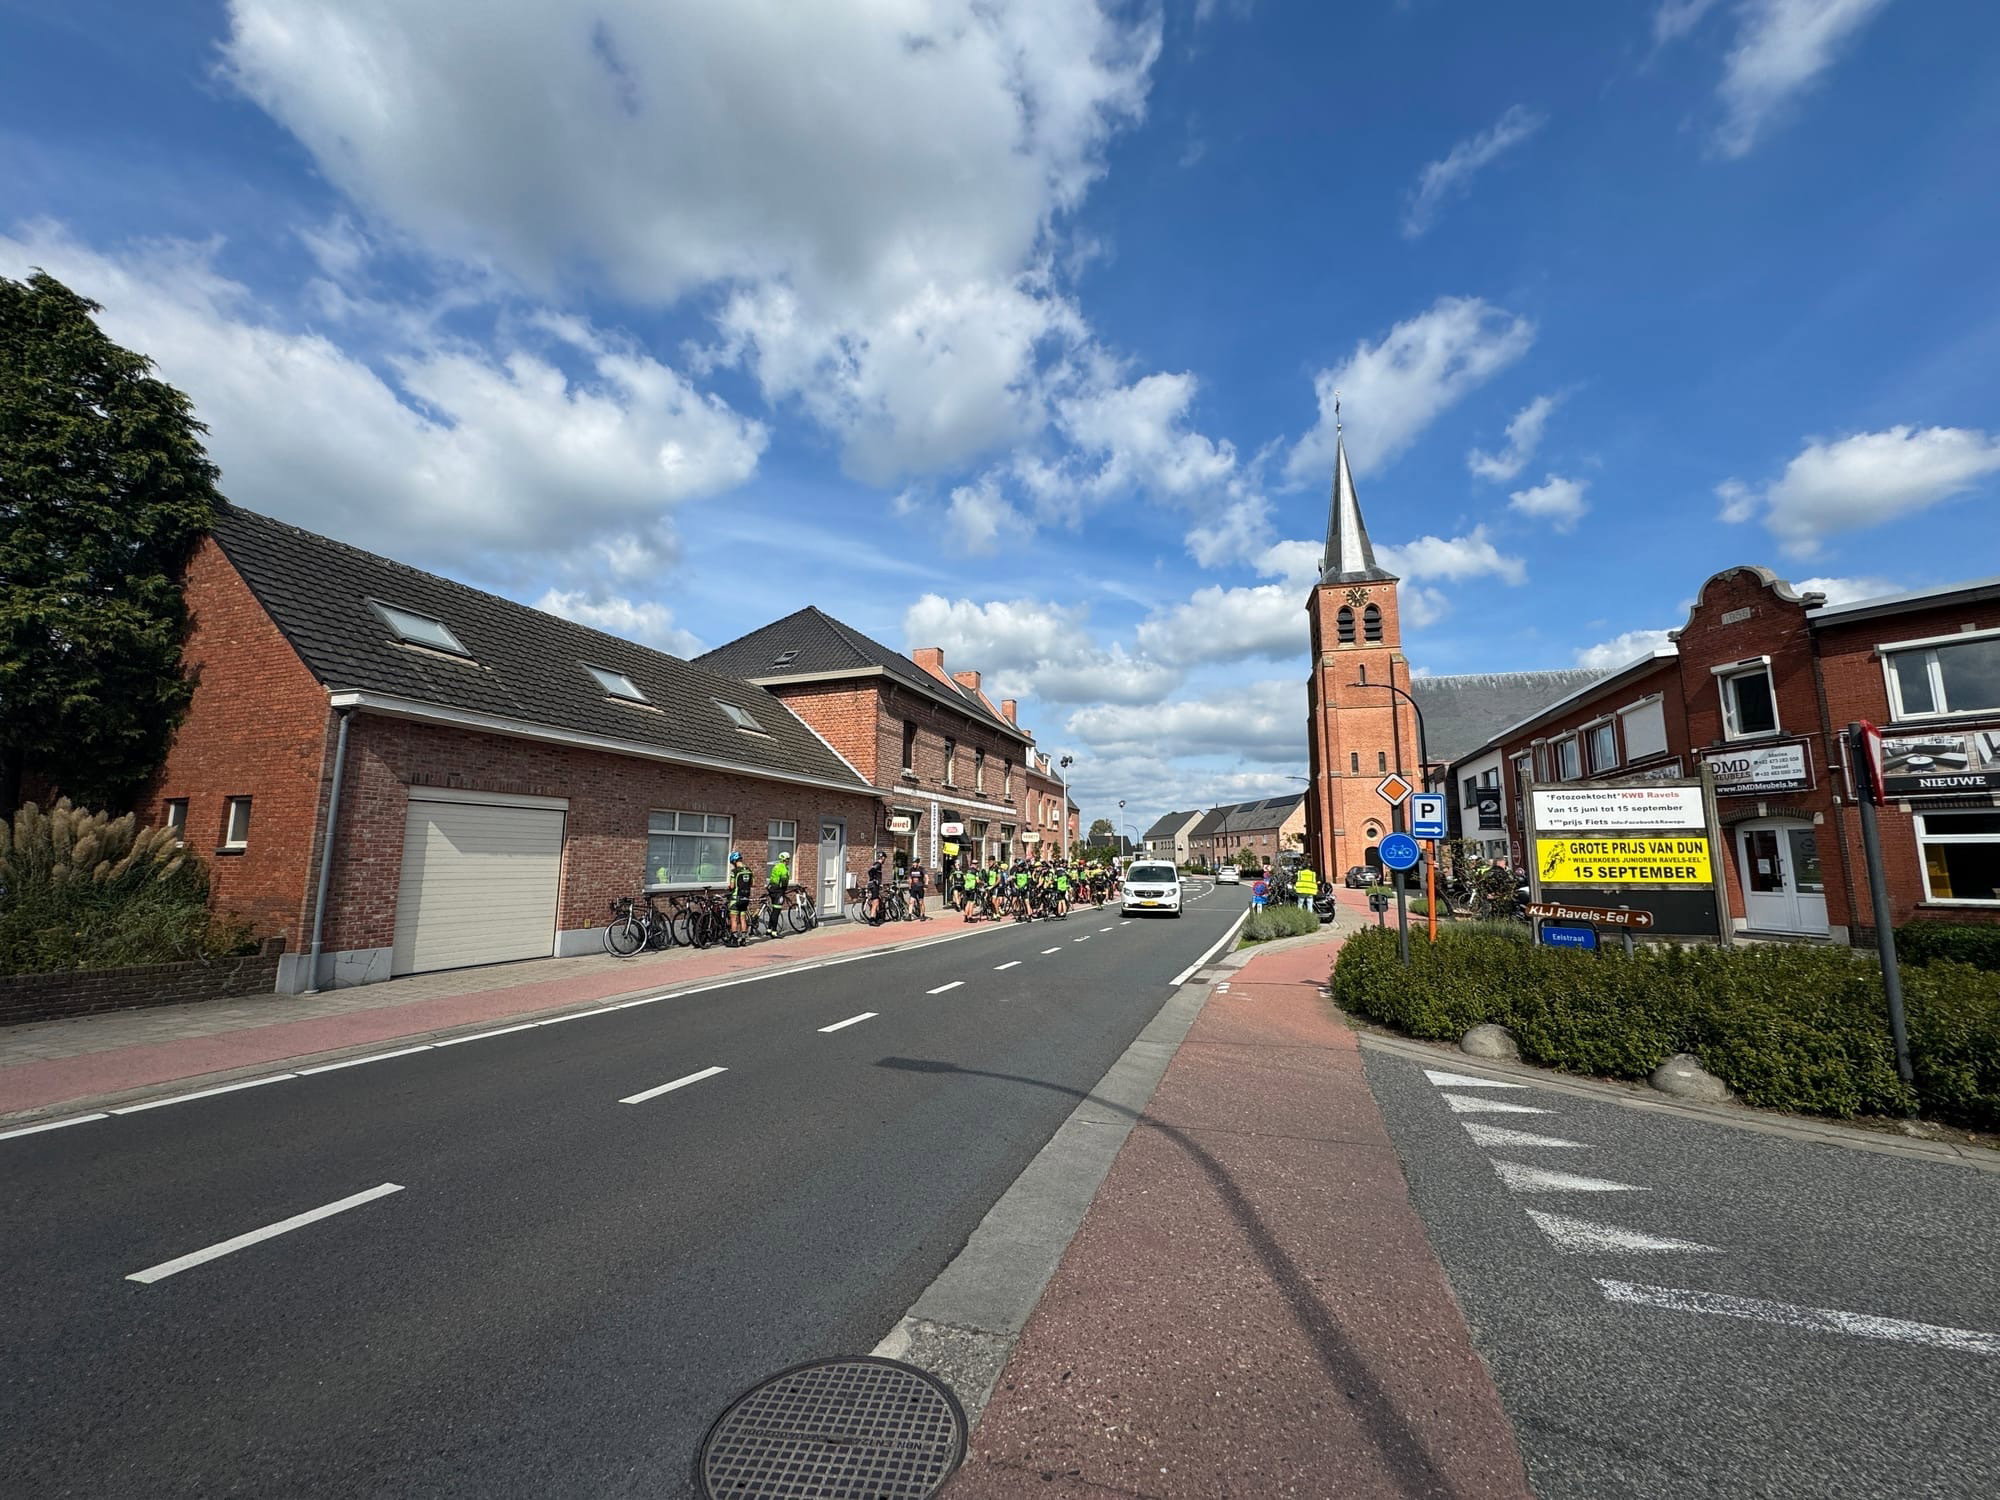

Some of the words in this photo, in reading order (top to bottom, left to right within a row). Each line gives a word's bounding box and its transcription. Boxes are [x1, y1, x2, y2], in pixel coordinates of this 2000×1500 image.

[1711, 759, 1750, 774] DMD
[1717, 780, 1799, 793] www.DMDMeubels.be
[1918, 775, 1987, 788] NIEUWE
[1421, 803, 1435, 818] P
[1581, 806, 1598, 814] juni
[1631, 805, 1683, 813] september
[1570, 842, 1608, 854] GROTE
[1612, 841, 1646, 854] PRIJS
[1649, 841, 1673, 854] VAN
[1677, 841, 1703, 854] DUN
[1573, 866, 1593, 878] 15
[1598, 866, 1697, 878] SEPTEMBER
[1528, 905, 1554, 917] KLJ
[1556, 907, 1629, 923] Ravels-Eel
[1552, 933, 1585, 943] Eelstraat
